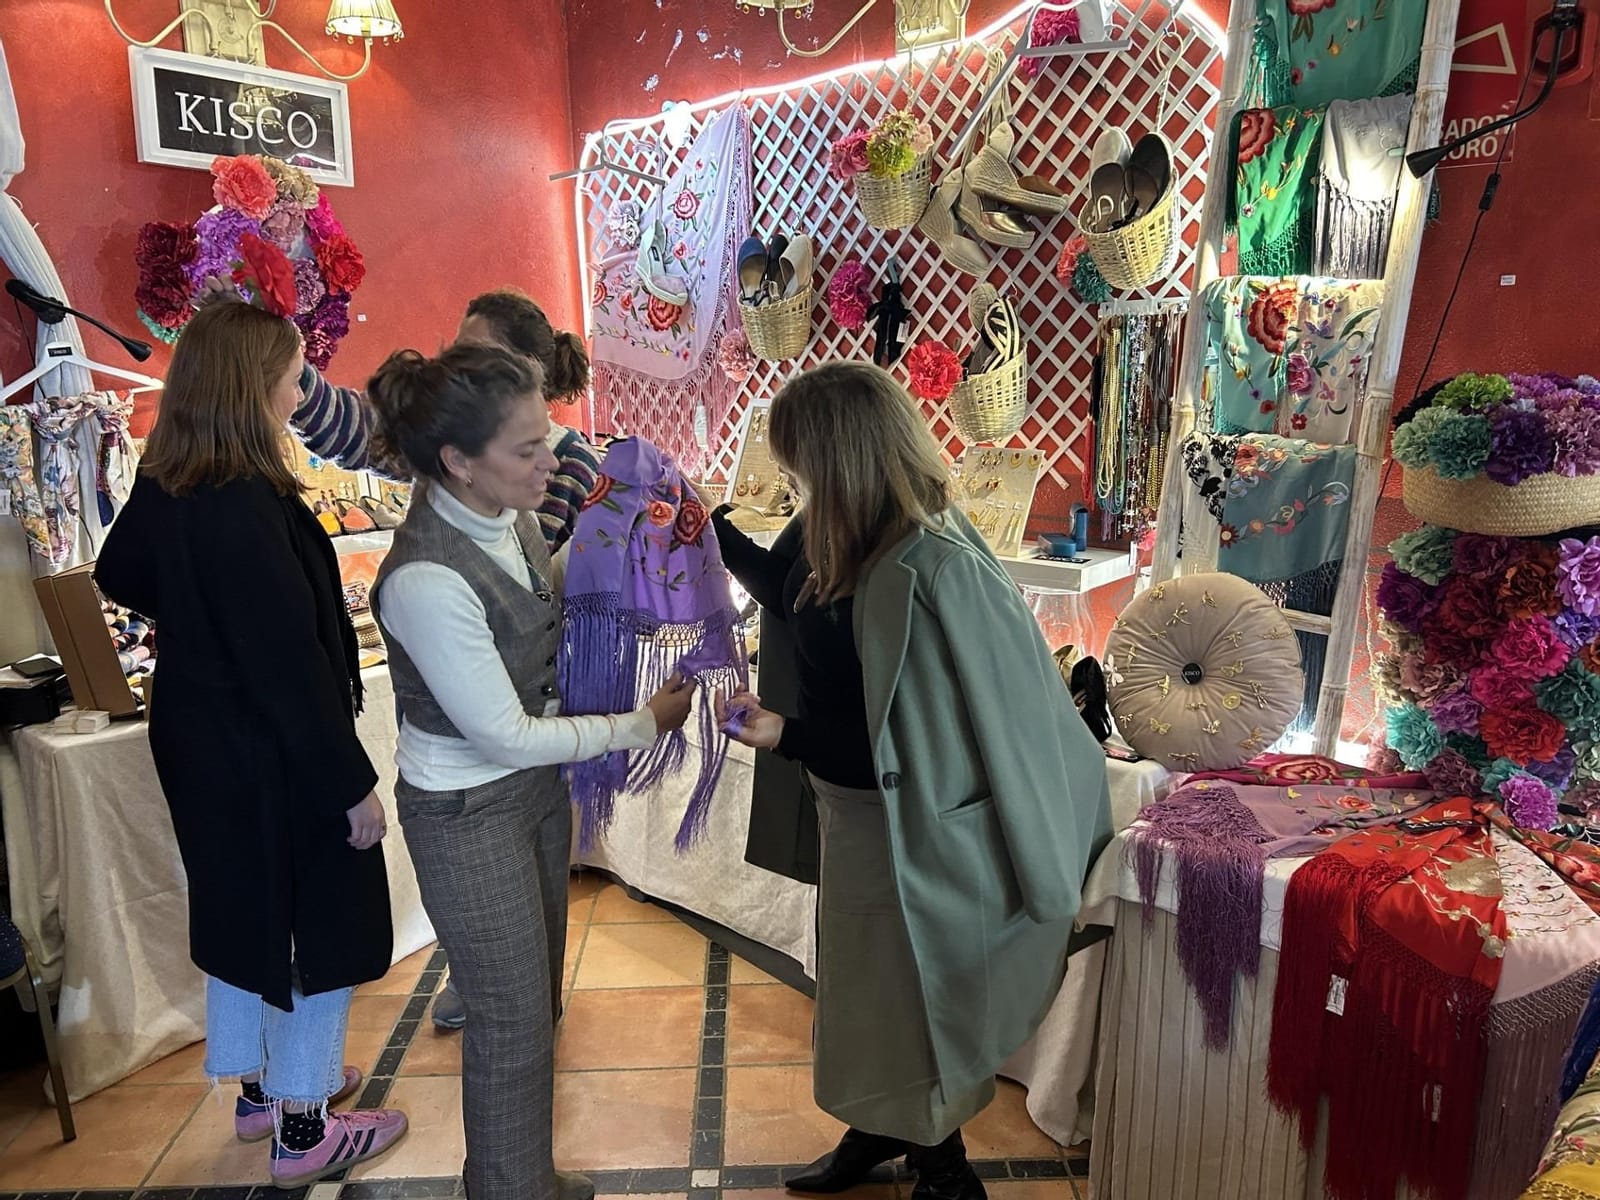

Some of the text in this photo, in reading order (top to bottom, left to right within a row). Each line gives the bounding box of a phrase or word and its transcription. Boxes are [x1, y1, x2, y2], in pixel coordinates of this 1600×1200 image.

[174, 91, 318, 149] KISCO
[1440, 114, 1511, 140] ADOR
[1441, 135, 1498, 161] ORO
